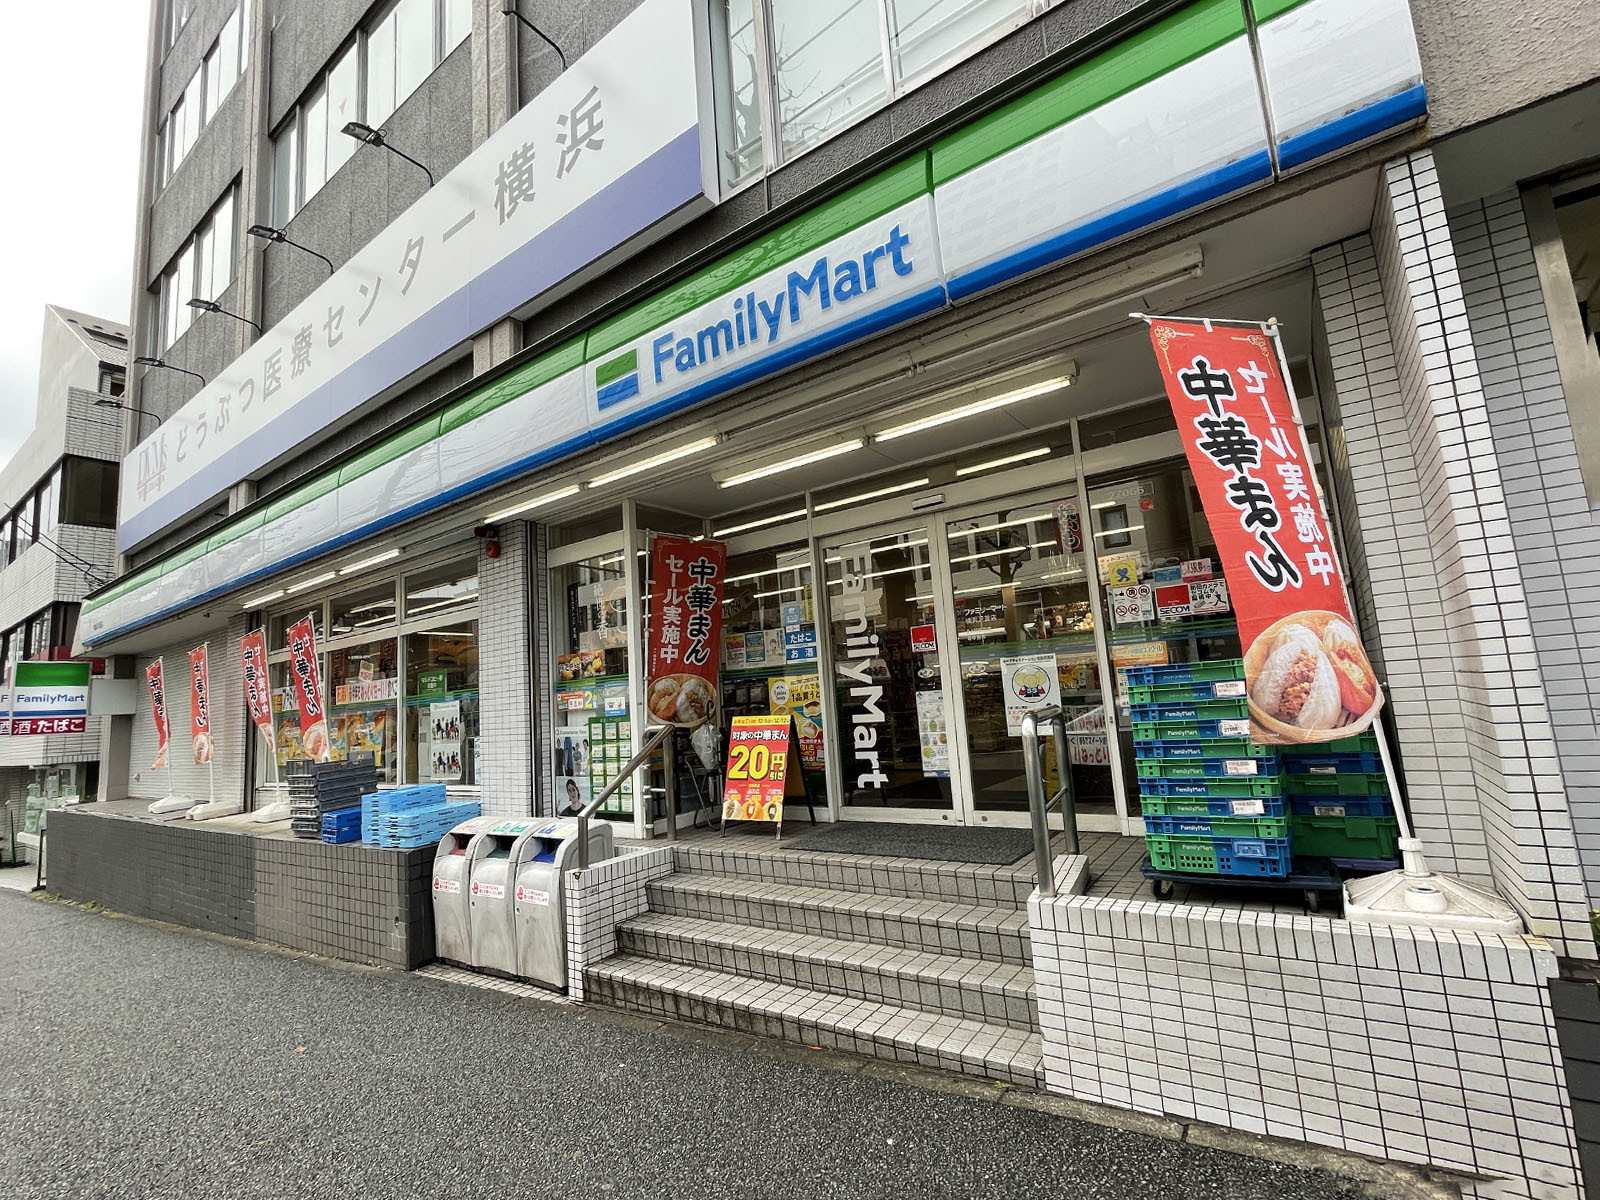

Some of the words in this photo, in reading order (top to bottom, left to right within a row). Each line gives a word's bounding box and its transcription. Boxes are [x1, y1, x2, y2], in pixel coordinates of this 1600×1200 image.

[174, 85, 605, 463] どうぶつ医療センター横浜
[652, 223, 914, 385] FamilyMart
[659, 554, 683, 664] セール実施中
[683, 556, 718, 666] 中華まん
[963, 604, 1008, 616] ファミリーマート
[1159, 605, 1191, 615] SECOM
[839, 551, 890, 790] FamilyMart
[16, 693, 86, 704] FamilyMart
[13, 718, 84, 734] 酒・たばこ
[732, 729, 789, 741] 対象の中華まん
[1175, 786, 1206, 794] FamilyMart
[1180, 824, 1211, 832] FamilyMart
